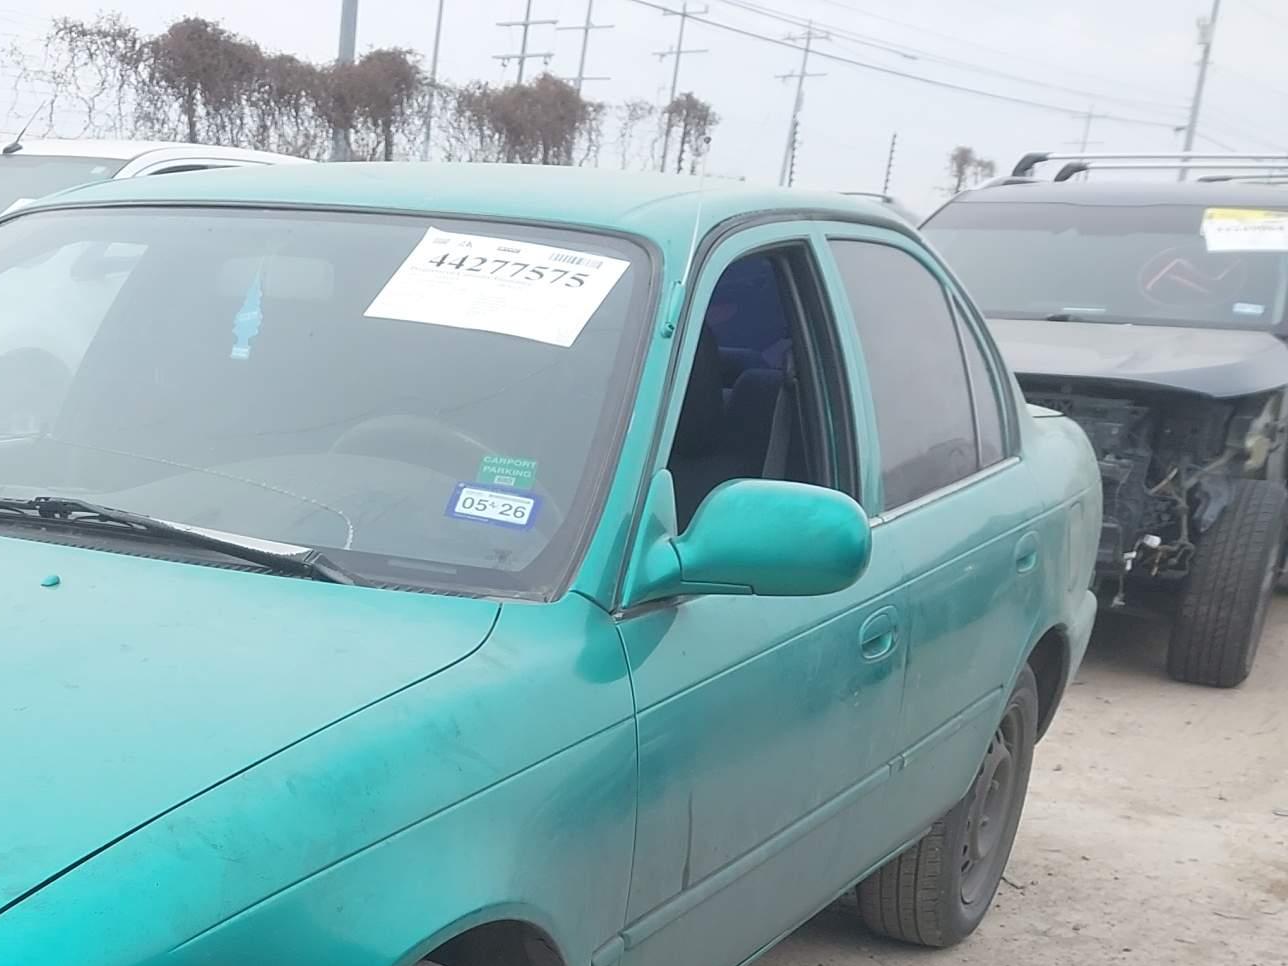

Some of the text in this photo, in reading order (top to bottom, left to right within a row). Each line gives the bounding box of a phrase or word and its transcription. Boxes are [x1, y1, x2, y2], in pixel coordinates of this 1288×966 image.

[429, 253, 590, 288] 44277575
[483, 456, 537, 469] CARPORT
[482, 466, 533, 478] PARKING
[462, 496, 489, 512] 05
[498, 503, 527, 519] 26
